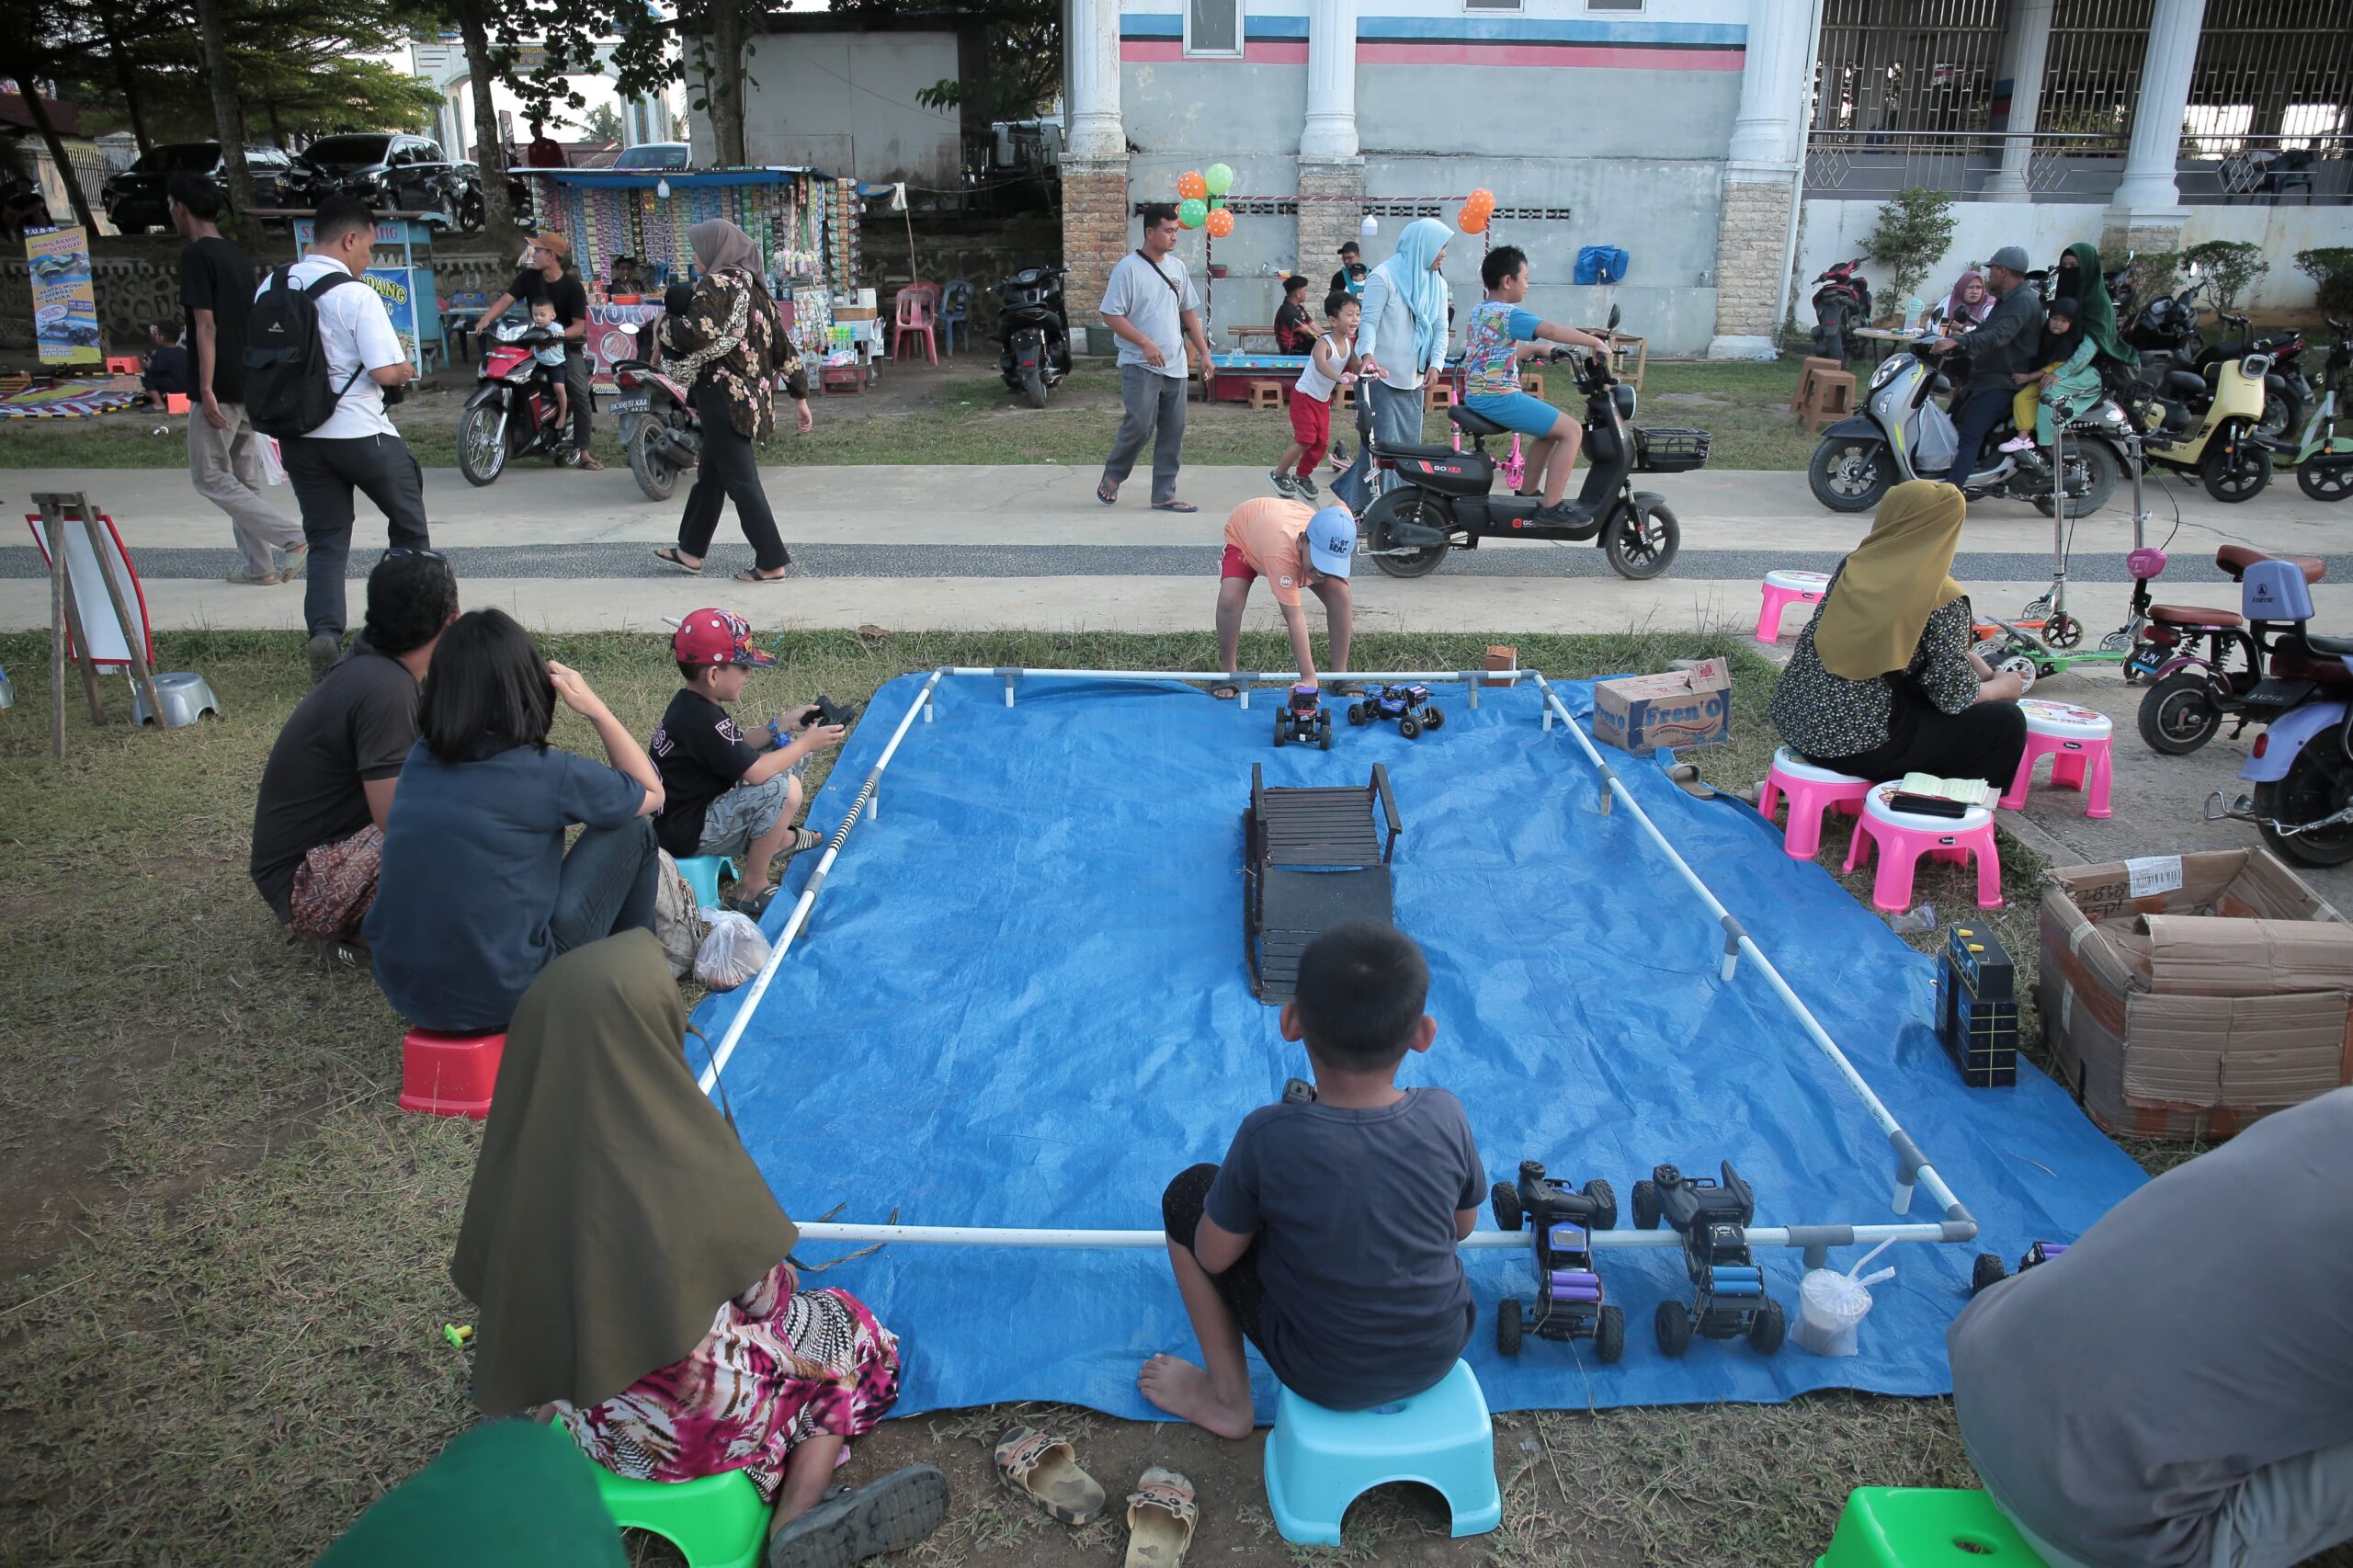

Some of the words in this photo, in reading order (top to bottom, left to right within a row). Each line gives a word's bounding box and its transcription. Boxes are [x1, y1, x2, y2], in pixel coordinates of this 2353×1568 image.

[49, 242, 83, 253] OFFROAD
[634, 398, 647, 406] XAA
[1644, 698, 1722, 727] Fren'O
[718, 721, 732, 732] MLS
